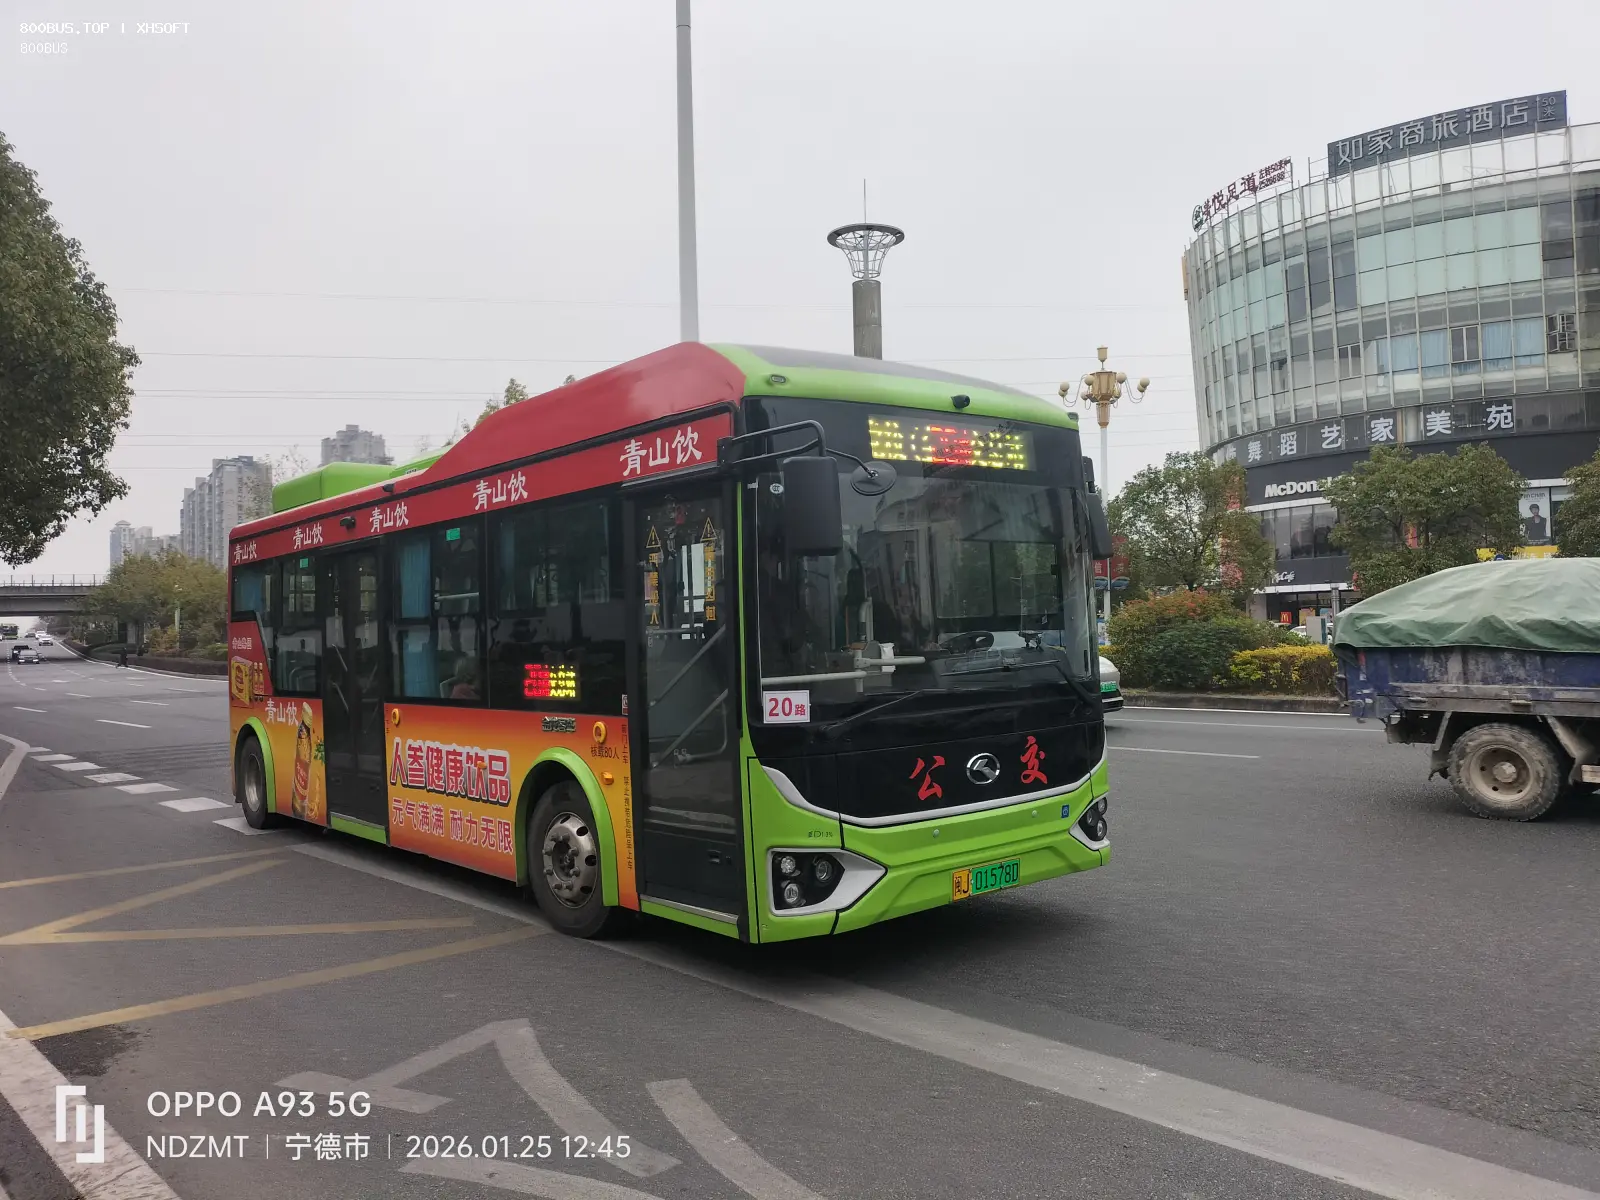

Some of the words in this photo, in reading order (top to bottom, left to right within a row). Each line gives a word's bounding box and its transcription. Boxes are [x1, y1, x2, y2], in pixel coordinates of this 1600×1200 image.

[1542, 96, 1556, 107] 50
[1543, 106, 1556, 117] 米
[1335, 98, 1529, 166] 如家商旅酒店
[620, 425, 703, 477] 青山饮
[472, 470, 529, 511] 青山饮
[369, 501, 409, 533] 青山饮
[292, 522, 323, 550] 青山饮
[233, 540, 257, 564] 青山饮
[265, 698, 299, 727] 青山饮
[591, 745, 620, 760] 核载80人
[393, 797, 445, 838] 元气满满
[449, 808, 513, 855] 耐力无限
